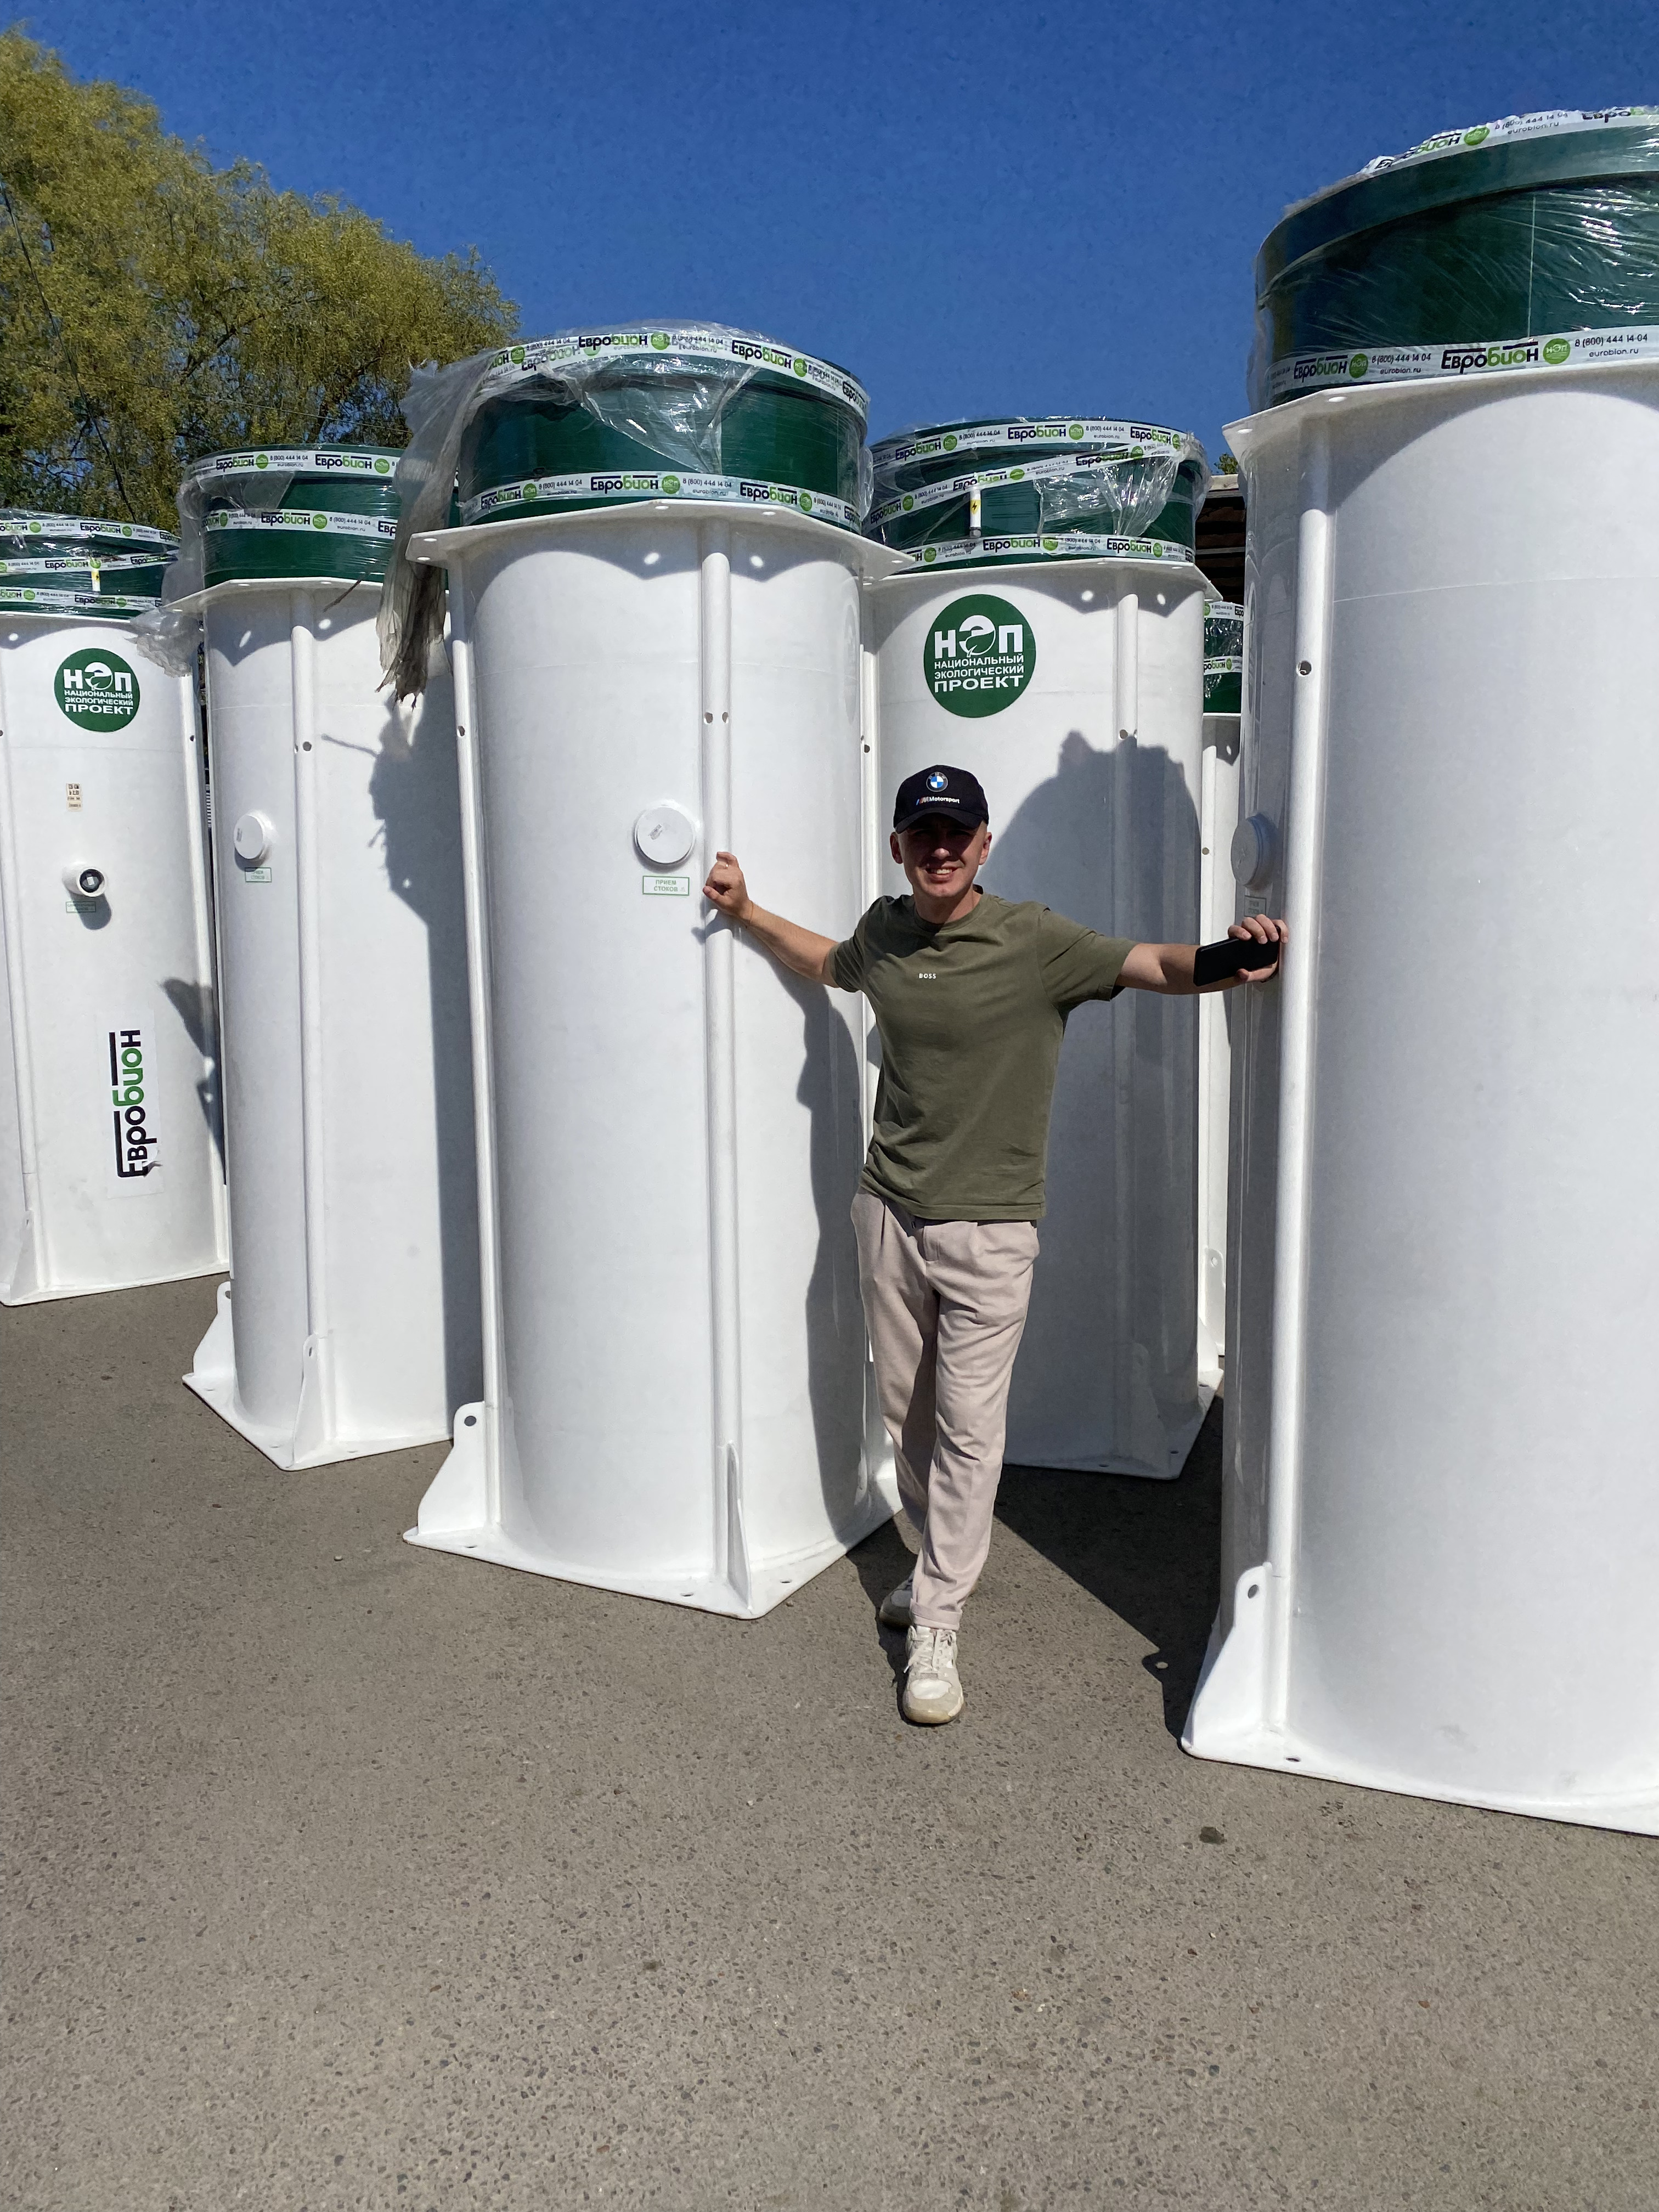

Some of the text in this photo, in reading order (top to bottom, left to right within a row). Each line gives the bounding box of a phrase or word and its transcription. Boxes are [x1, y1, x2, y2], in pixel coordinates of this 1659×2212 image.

[1508, 122, 1559, 134] eurobion.ru
[1546, 343, 1567, 354] НЭП
[1582, 337, 1604, 348] (800)
[1637, 334, 1647, 343] 04
[732, 340, 792, 369] Евробион
[1377, 354, 1393, 365] (800)
[1395, 354, 1410, 363] 444
[1421, 353, 1431, 362] 04
[1441, 341, 1538, 374] Евробион
[1589, 348, 1639, 357] eurobion.ru
[1294, 354, 1348, 383] Евробион
[1008, 425, 1066, 442] Евробион
[1130, 426, 1171, 444] Евробион
[895, 437, 941, 461] Евробион
[315, 454, 372, 469] Евробион
[591, 475, 658, 494] Евробион
[741, 482, 797, 505] Евробион
[261, 512, 311, 526] Евробион
[983, 537, 1040, 553] Евробион
[1107, 538, 1152, 554] Евробион
[45, 560, 88, 570] Евробион
[934, 614, 1023, 659] НЭП
[934, 653, 1024, 669] НАЦИОНАЛЬНЫЙ
[63, 662, 132, 692] НЭП
[934, 663, 1024, 679] ЭКОЛОГИЧЕСКИЙ
[934, 675, 1024, 693] ПРОЕКТ
[64, 690, 133, 699] НАЦИОНАЛЬНЫЙ
[65, 697, 133, 706] ЭКОЛОГИЧЕСКИЙ
[65, 703, 133, 715] ПРОЕКТ
[109, 1030, 157, 1178] Евробион
